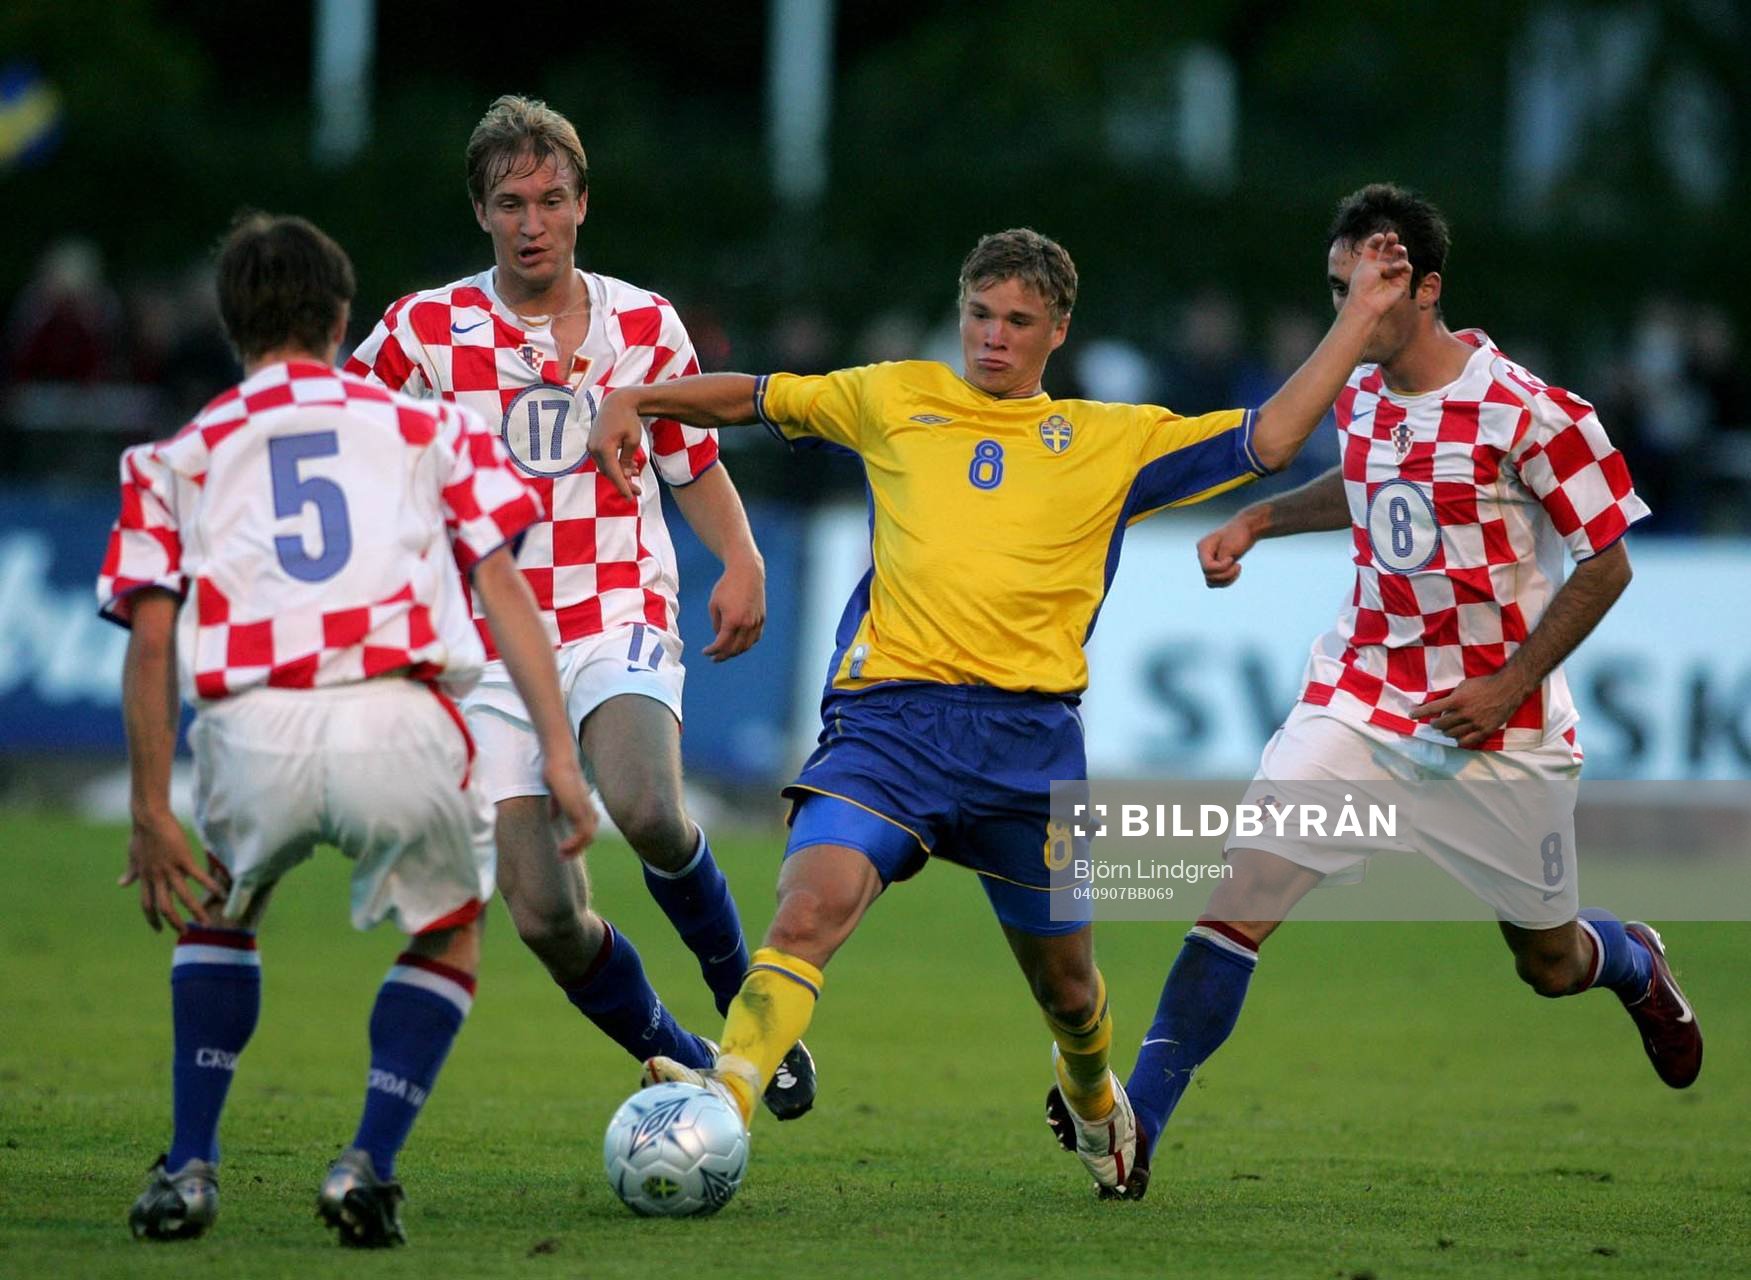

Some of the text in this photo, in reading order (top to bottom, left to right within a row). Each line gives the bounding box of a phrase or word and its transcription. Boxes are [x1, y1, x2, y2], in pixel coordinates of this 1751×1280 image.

[527, 399, 570, 461] 17
[969, 439, 1004, 490] 8
[268, 429, 354, 583] 5
[1389, 496, 1413, 558] 8
[1044, 819, 1073, 871] 8
[1540, 832, 1564, 887] 8
